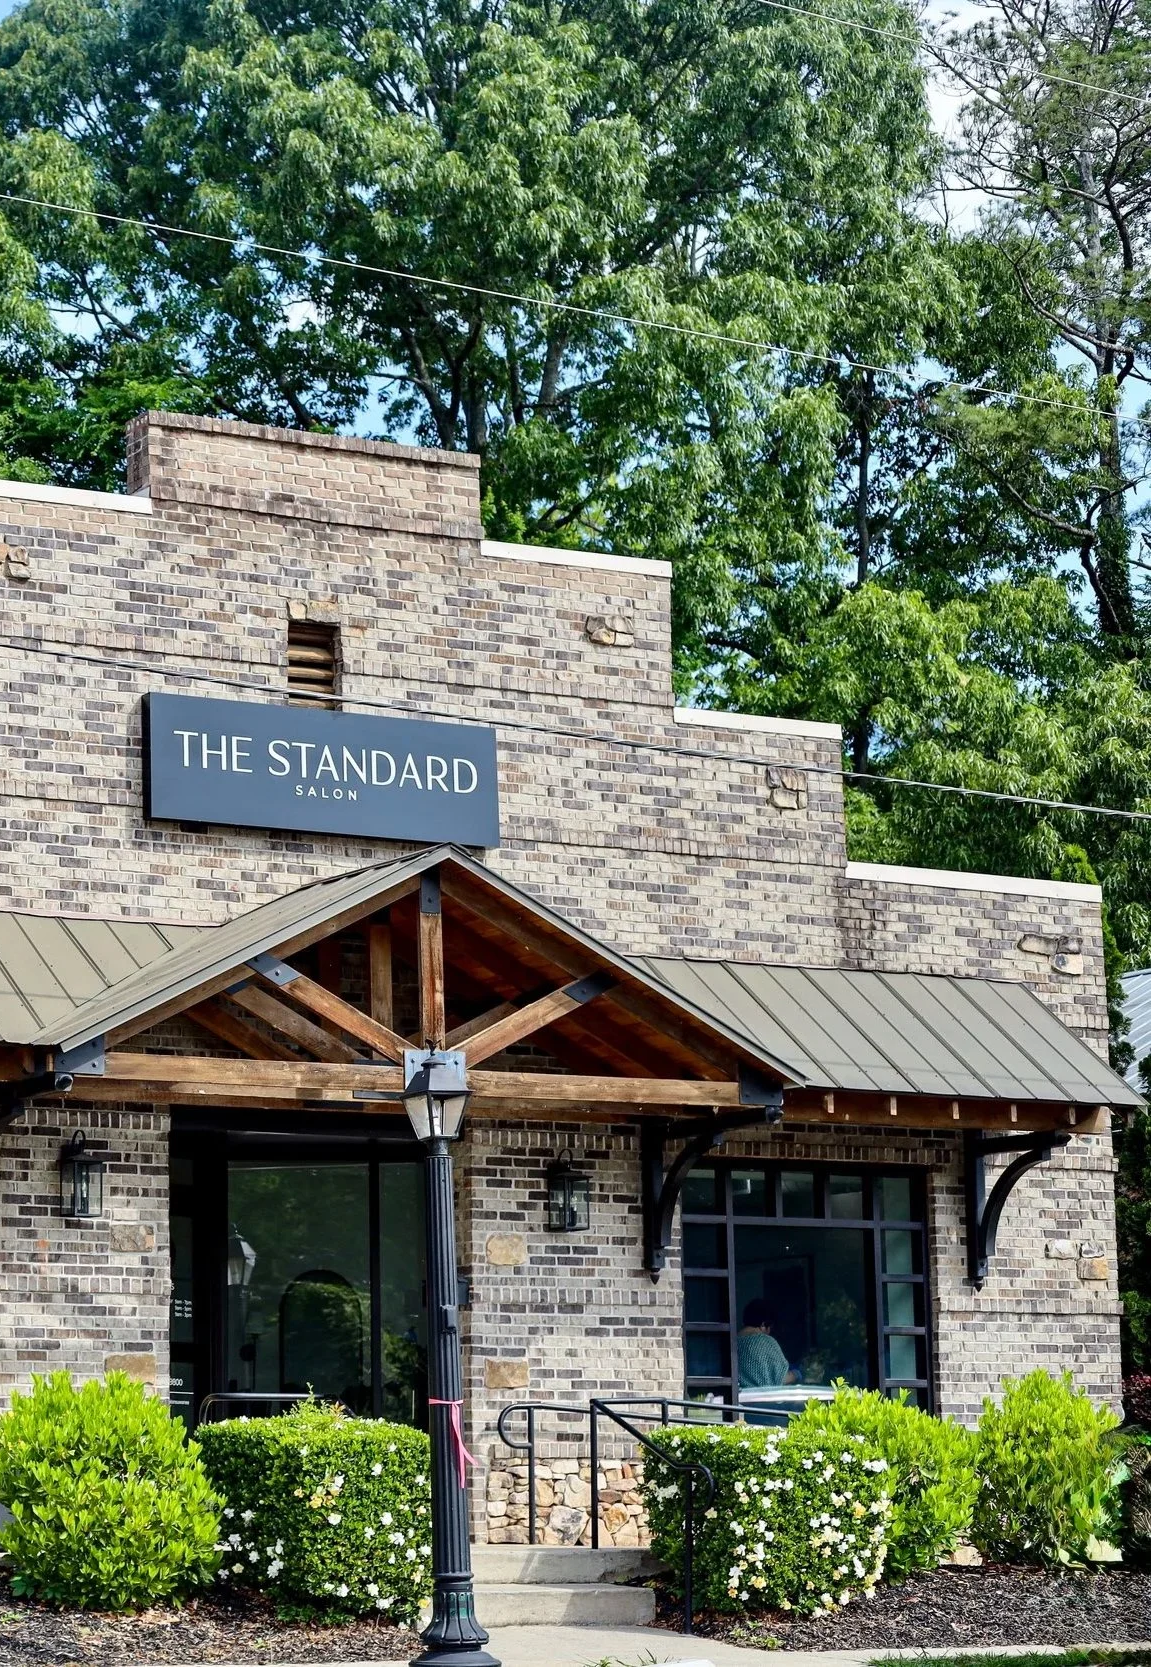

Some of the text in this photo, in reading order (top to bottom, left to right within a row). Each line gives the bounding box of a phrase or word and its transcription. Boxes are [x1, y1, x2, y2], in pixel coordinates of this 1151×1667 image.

[173, 730, 478, 794] THE STANDARD
[295, 784, 357, 801] SALON
